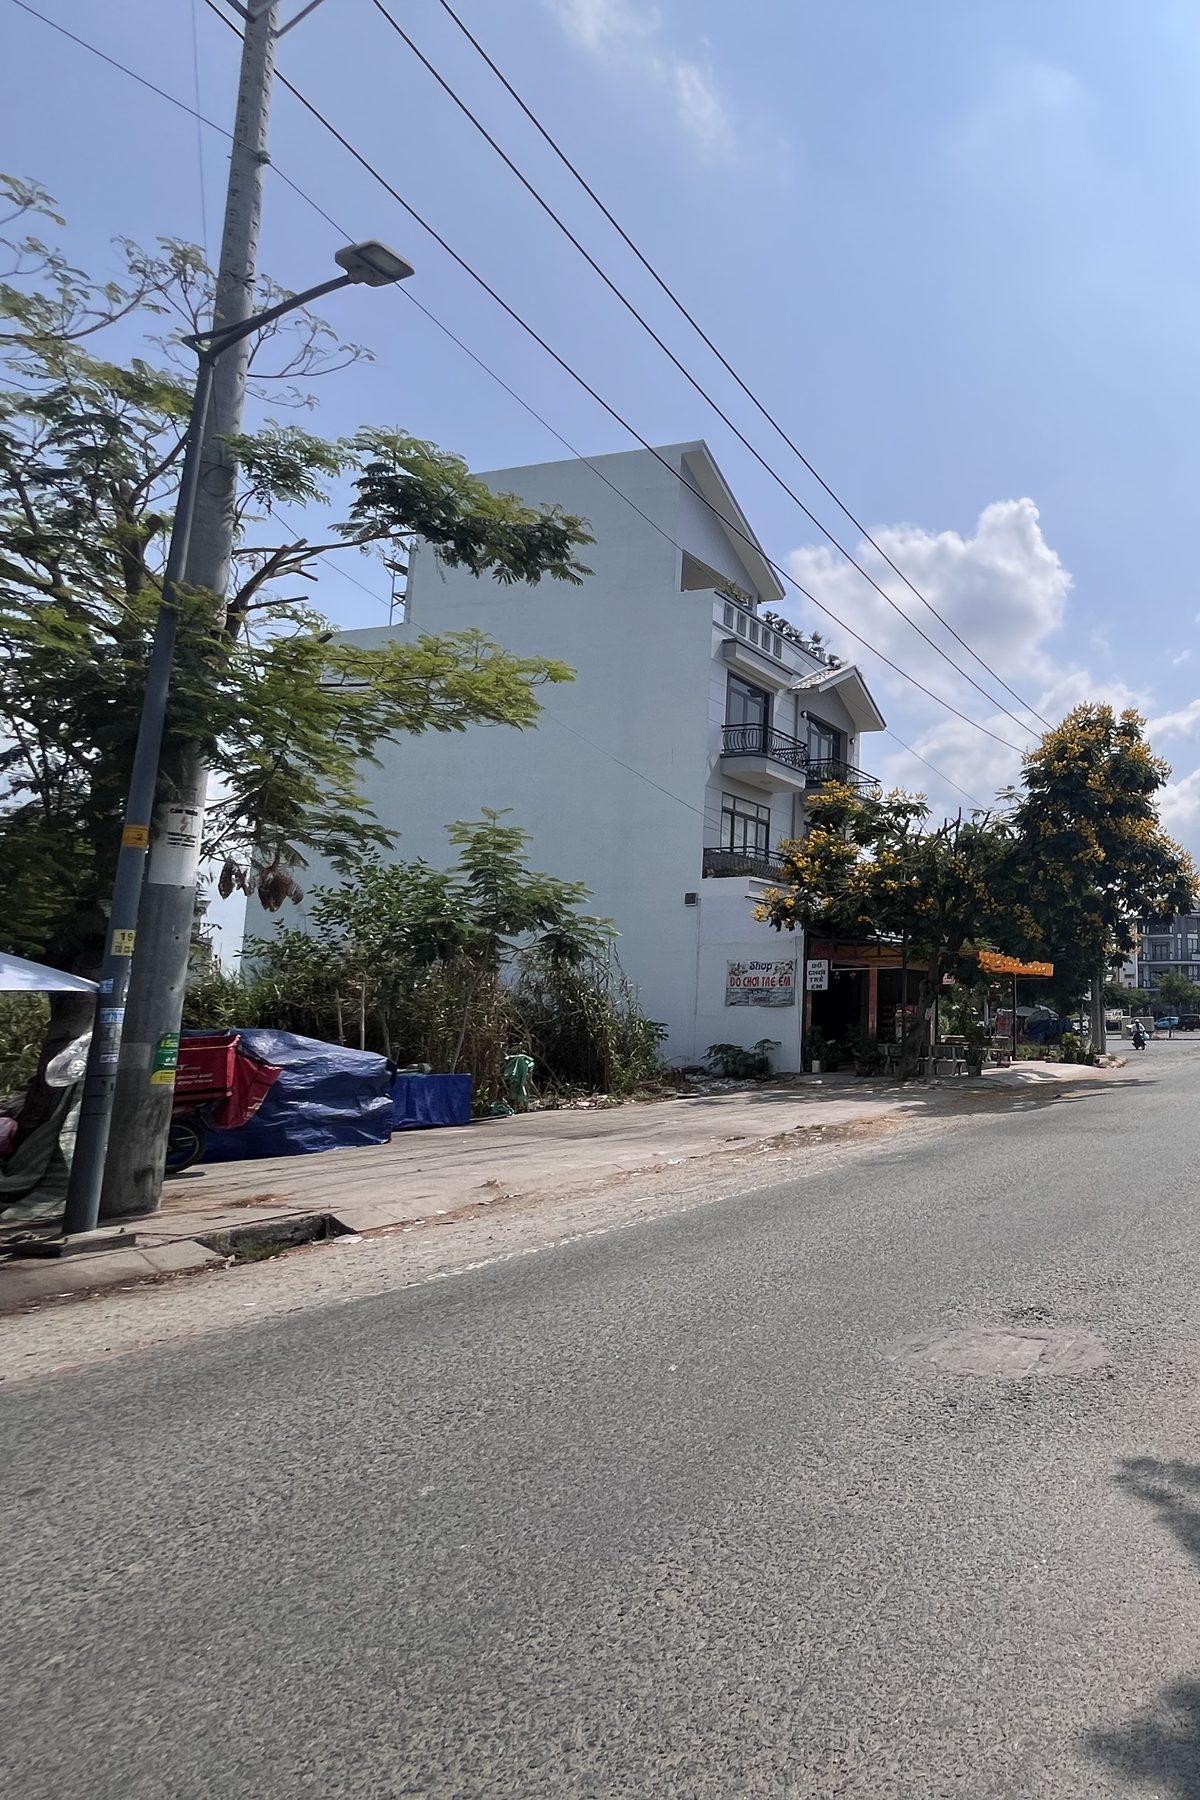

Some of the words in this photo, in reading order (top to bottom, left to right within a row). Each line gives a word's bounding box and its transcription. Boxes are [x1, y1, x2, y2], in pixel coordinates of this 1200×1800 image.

[120, 932, 135, 942] 19
[749, 961, 772, 973] Shop
[778, 975, 791, 987] EM
